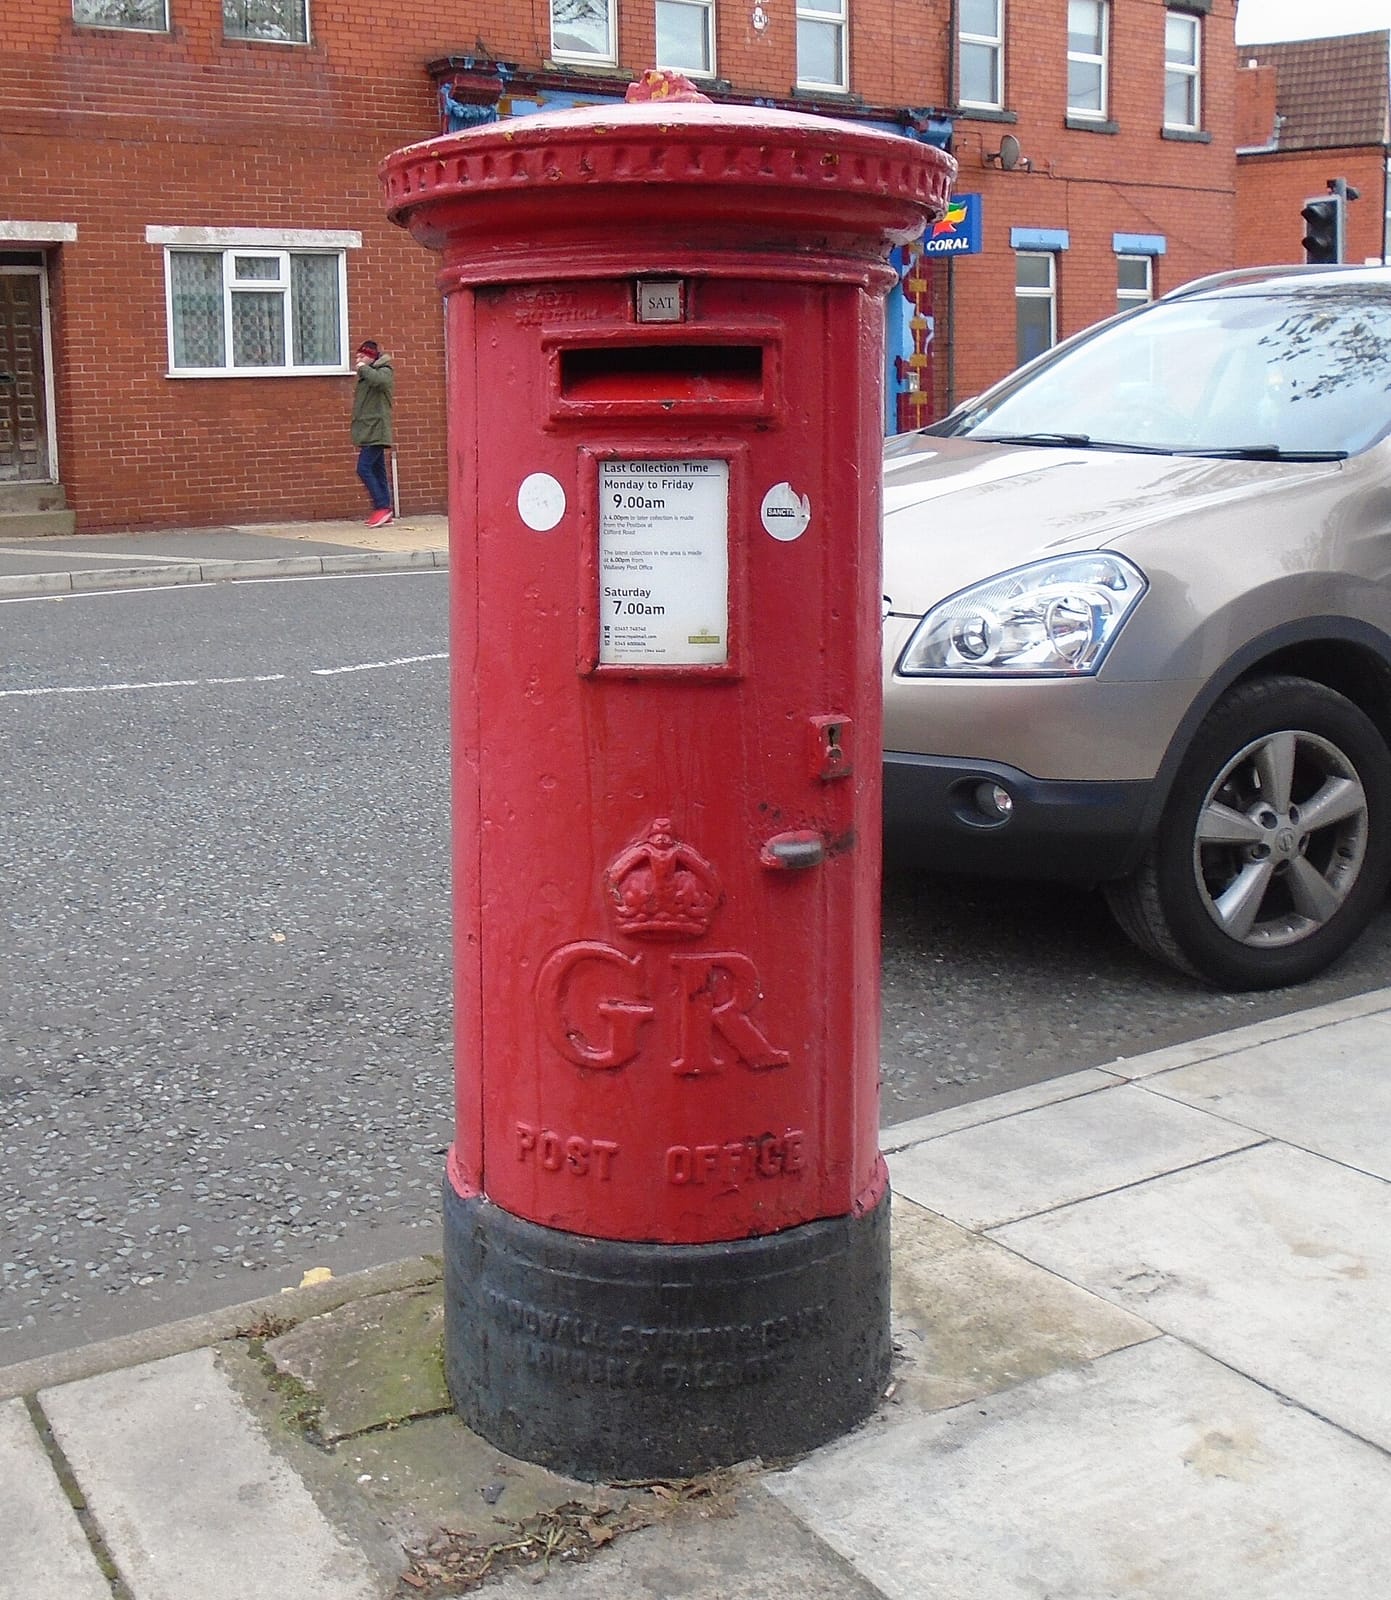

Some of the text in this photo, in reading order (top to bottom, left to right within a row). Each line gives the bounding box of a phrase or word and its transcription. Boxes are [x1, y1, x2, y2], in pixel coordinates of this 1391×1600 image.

[926, 238, 969, 251] CORAL
[648, 296, 674, 309] SAT
[604, 462, 709, 473] Last Collection Time
[604, 480, 694, 491] Monday to Friday
[613, 494, 665, 509] 9.00am
[604, 587, 651, 598] Saturday
[612, 600, 665, 615] 7.00am
[534, 939, 791, 1075] GR
[515, 1120, 805, 1184] POST OFFICE
